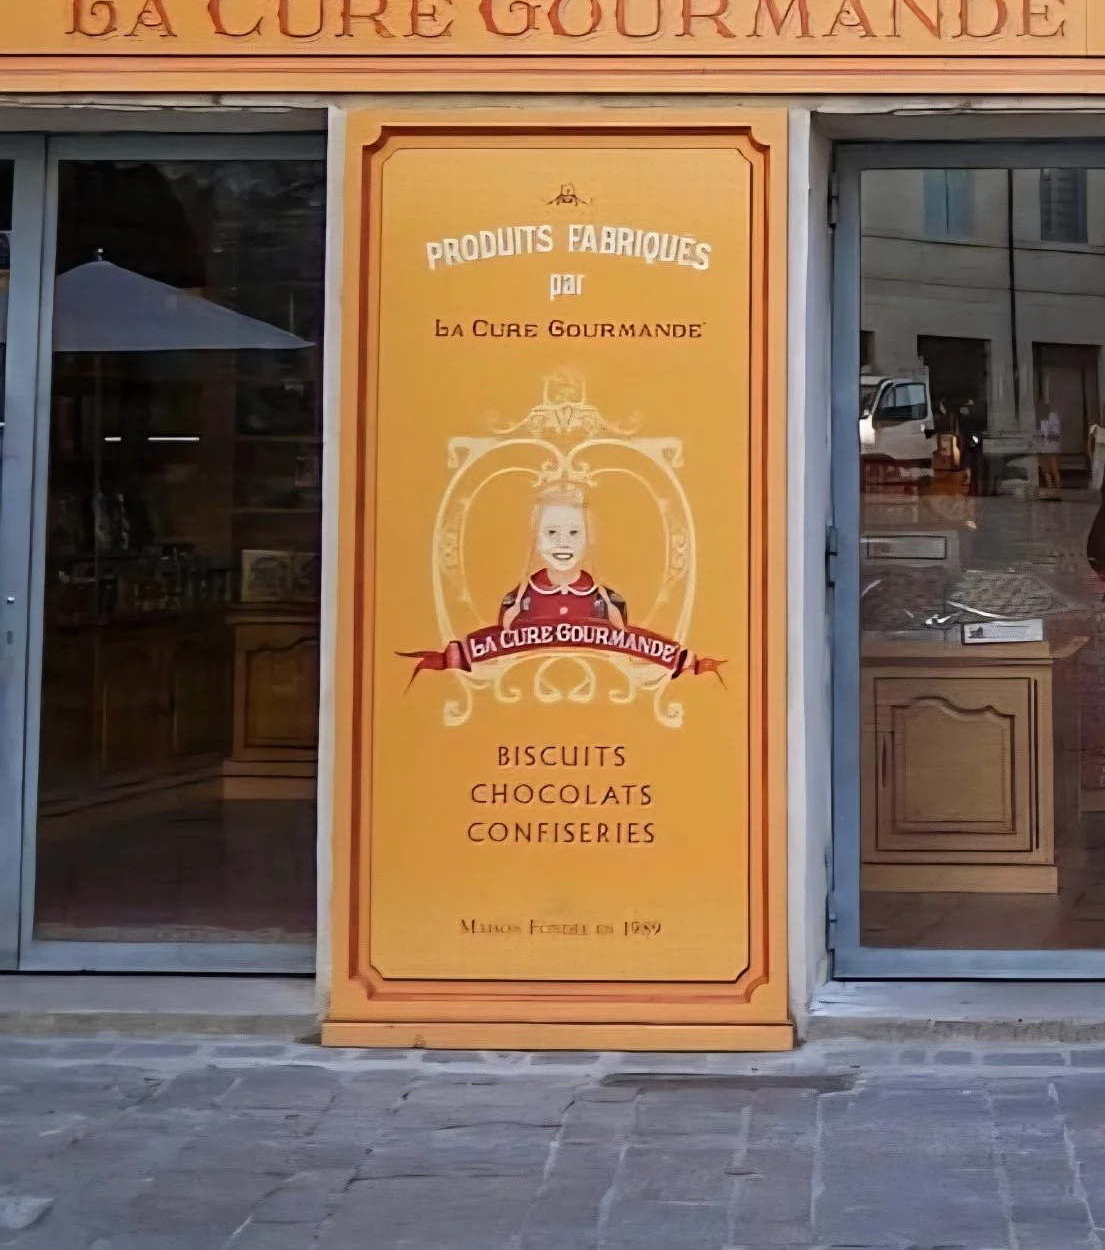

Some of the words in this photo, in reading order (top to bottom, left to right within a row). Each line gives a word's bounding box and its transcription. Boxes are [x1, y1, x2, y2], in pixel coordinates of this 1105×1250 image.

[426, 224, 553, 270] PRODUITS
[550, 273, 585, 301] par
[435, 319, 463, 338] LA
[472, 319, 538, 338] CURE
[548, 319, 702, 338] GOURMANDE
[470, 636, 498, 657] LA
[500, 625, 553, 649] CURE
[556, 623, 677, 663] GOURMANDE
[498, 746, 626, 766] BISCUITS
[471, 783, 652, 806] CHOCOLATS
[467, 822, 655, 844] CONFISERIES
